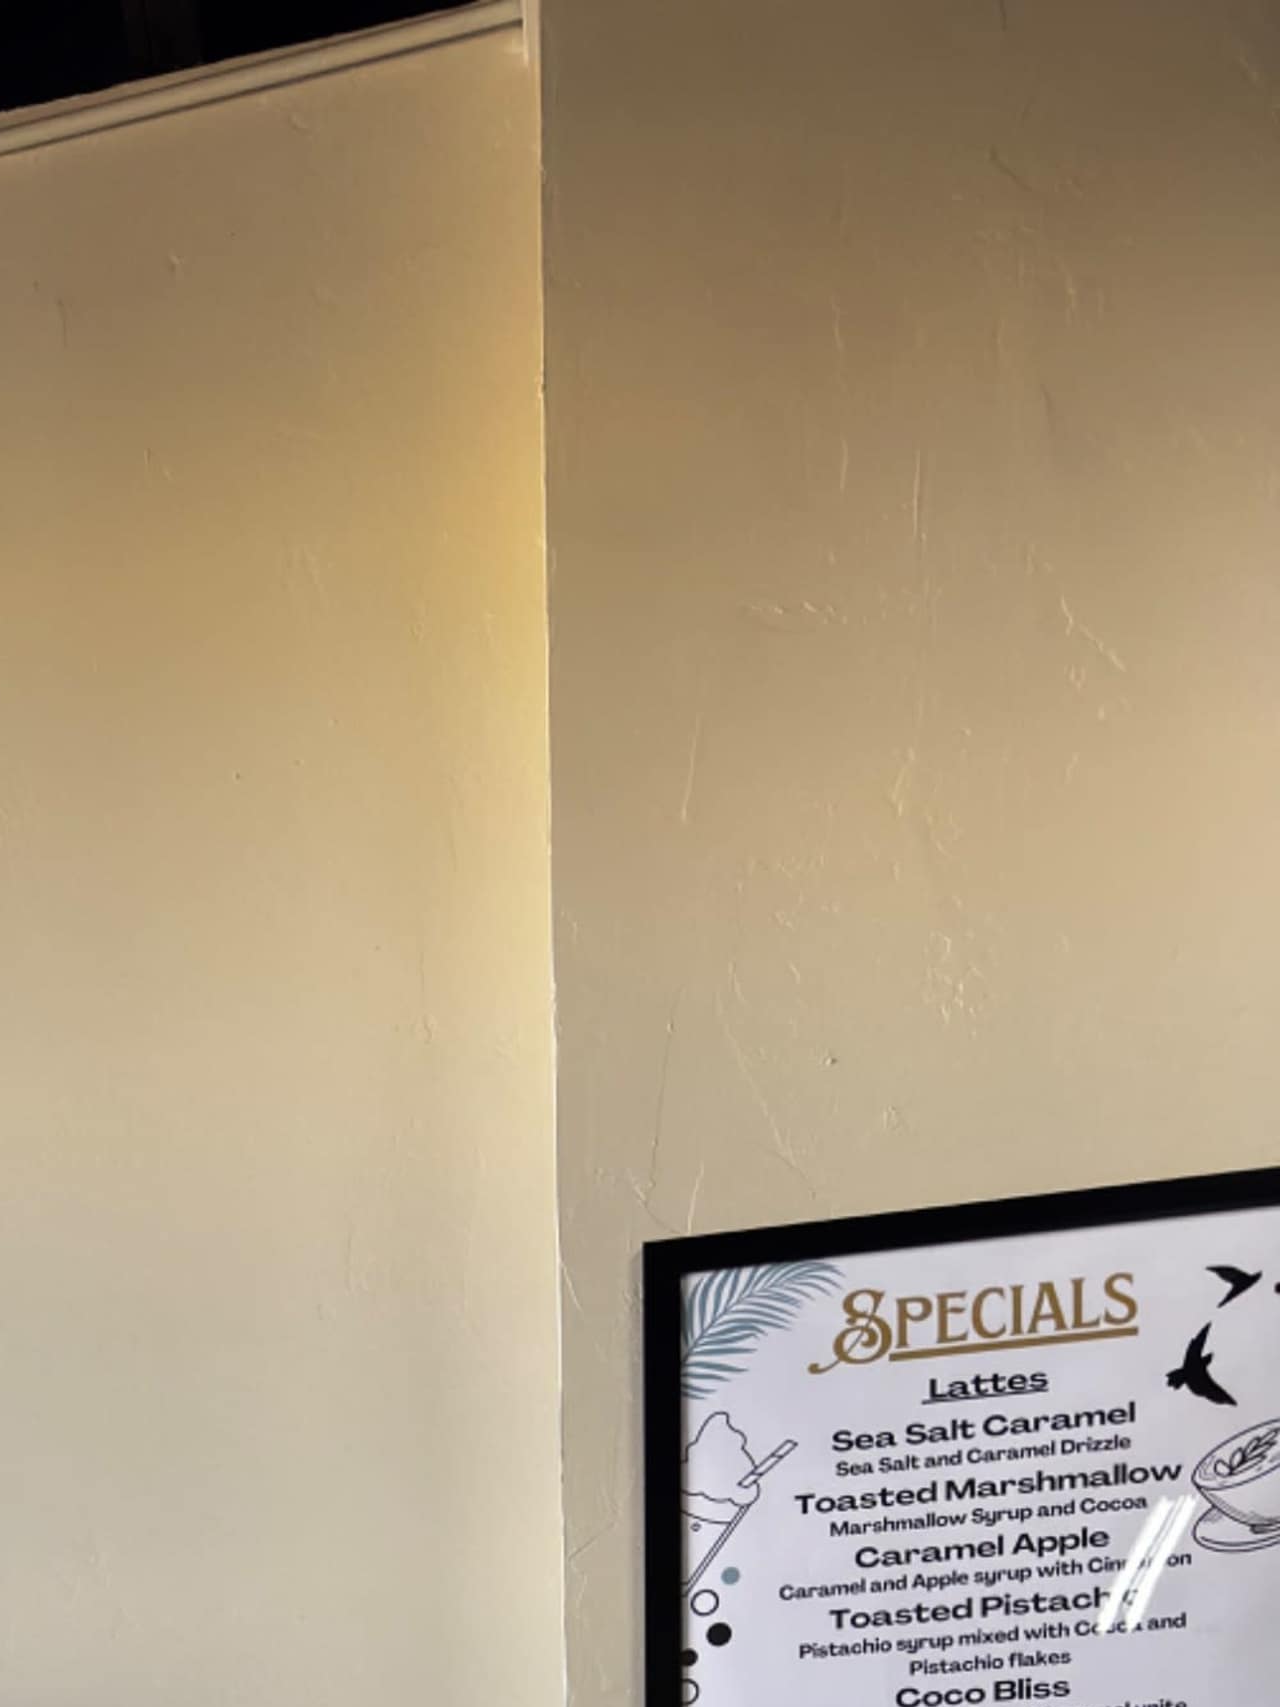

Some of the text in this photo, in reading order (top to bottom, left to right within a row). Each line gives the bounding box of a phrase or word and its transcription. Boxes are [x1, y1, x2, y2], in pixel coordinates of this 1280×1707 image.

[928, 1372, 1048, 1400] Lattes
[832, 1402, 1136, 1452] Sea Salt Caramel
[836, 1435, 1131, 1476] Sea Salt and Caramel Drizzle
[795, 1463, 1182, 1514] Toasted Marshmallow
[830, 1497, 1147, 1537] Marshmallow Syrup and Cocoa
[854, 1526, 1109, 1568] Caramel Apple
[779, 1552, 1191, 1600] Caramel and Apple syrup with Cinon
[829, 1595, 973, 1629] Toasted
[799, 1637, 892, 1659] Pistachio
[896, 1633, 954, 1654] syrup
[959, 1627, 1019, 1646] mixed
[1024, 1622, 1070, 1640] with
[1148, 1613, 1187, 1630] and
[909, 1649, 1071, 1675] Pistachio flakes
[993, 1678, 1070, 1700] Bliss
